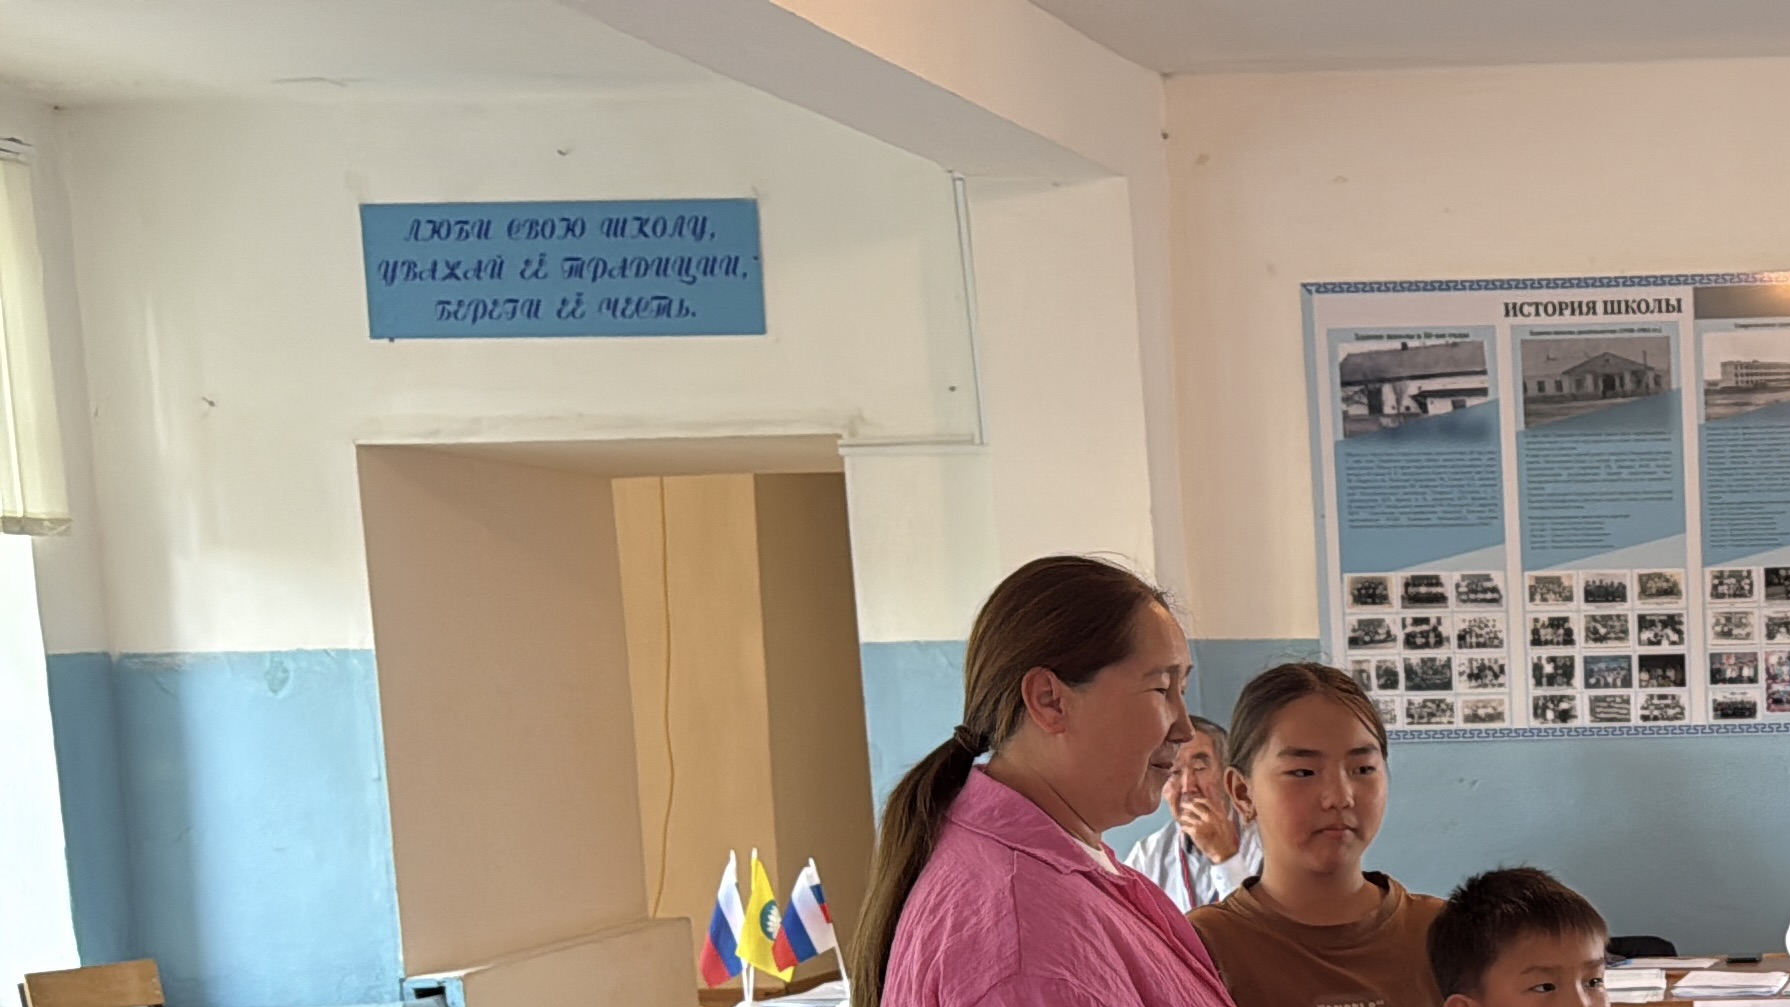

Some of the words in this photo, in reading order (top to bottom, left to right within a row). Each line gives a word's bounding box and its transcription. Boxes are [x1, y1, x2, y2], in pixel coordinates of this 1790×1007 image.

[404, 217, 492, 242] ЛЮБИ
[507, 217, 586, 240] СВОЮ
[600, 215, 717, 240] ШКОЛУ,
[378, 254, 505, 286] УВАЖАЙ
[519, 252, 549, 280] ЕЁ
[561, 253, 749, 286] ТРАДИЦИИ,
[435, 297, 543, 326] БЕРЕГИ
[555, 291, 586, 321] ЕЁ
[598, 295, 698, 320] ЧЕСТЬ.
[1503, 299, 1597, 318] ИСТОРИЯ
[1602, 297, 1683, 316] ШКОЛЫ
